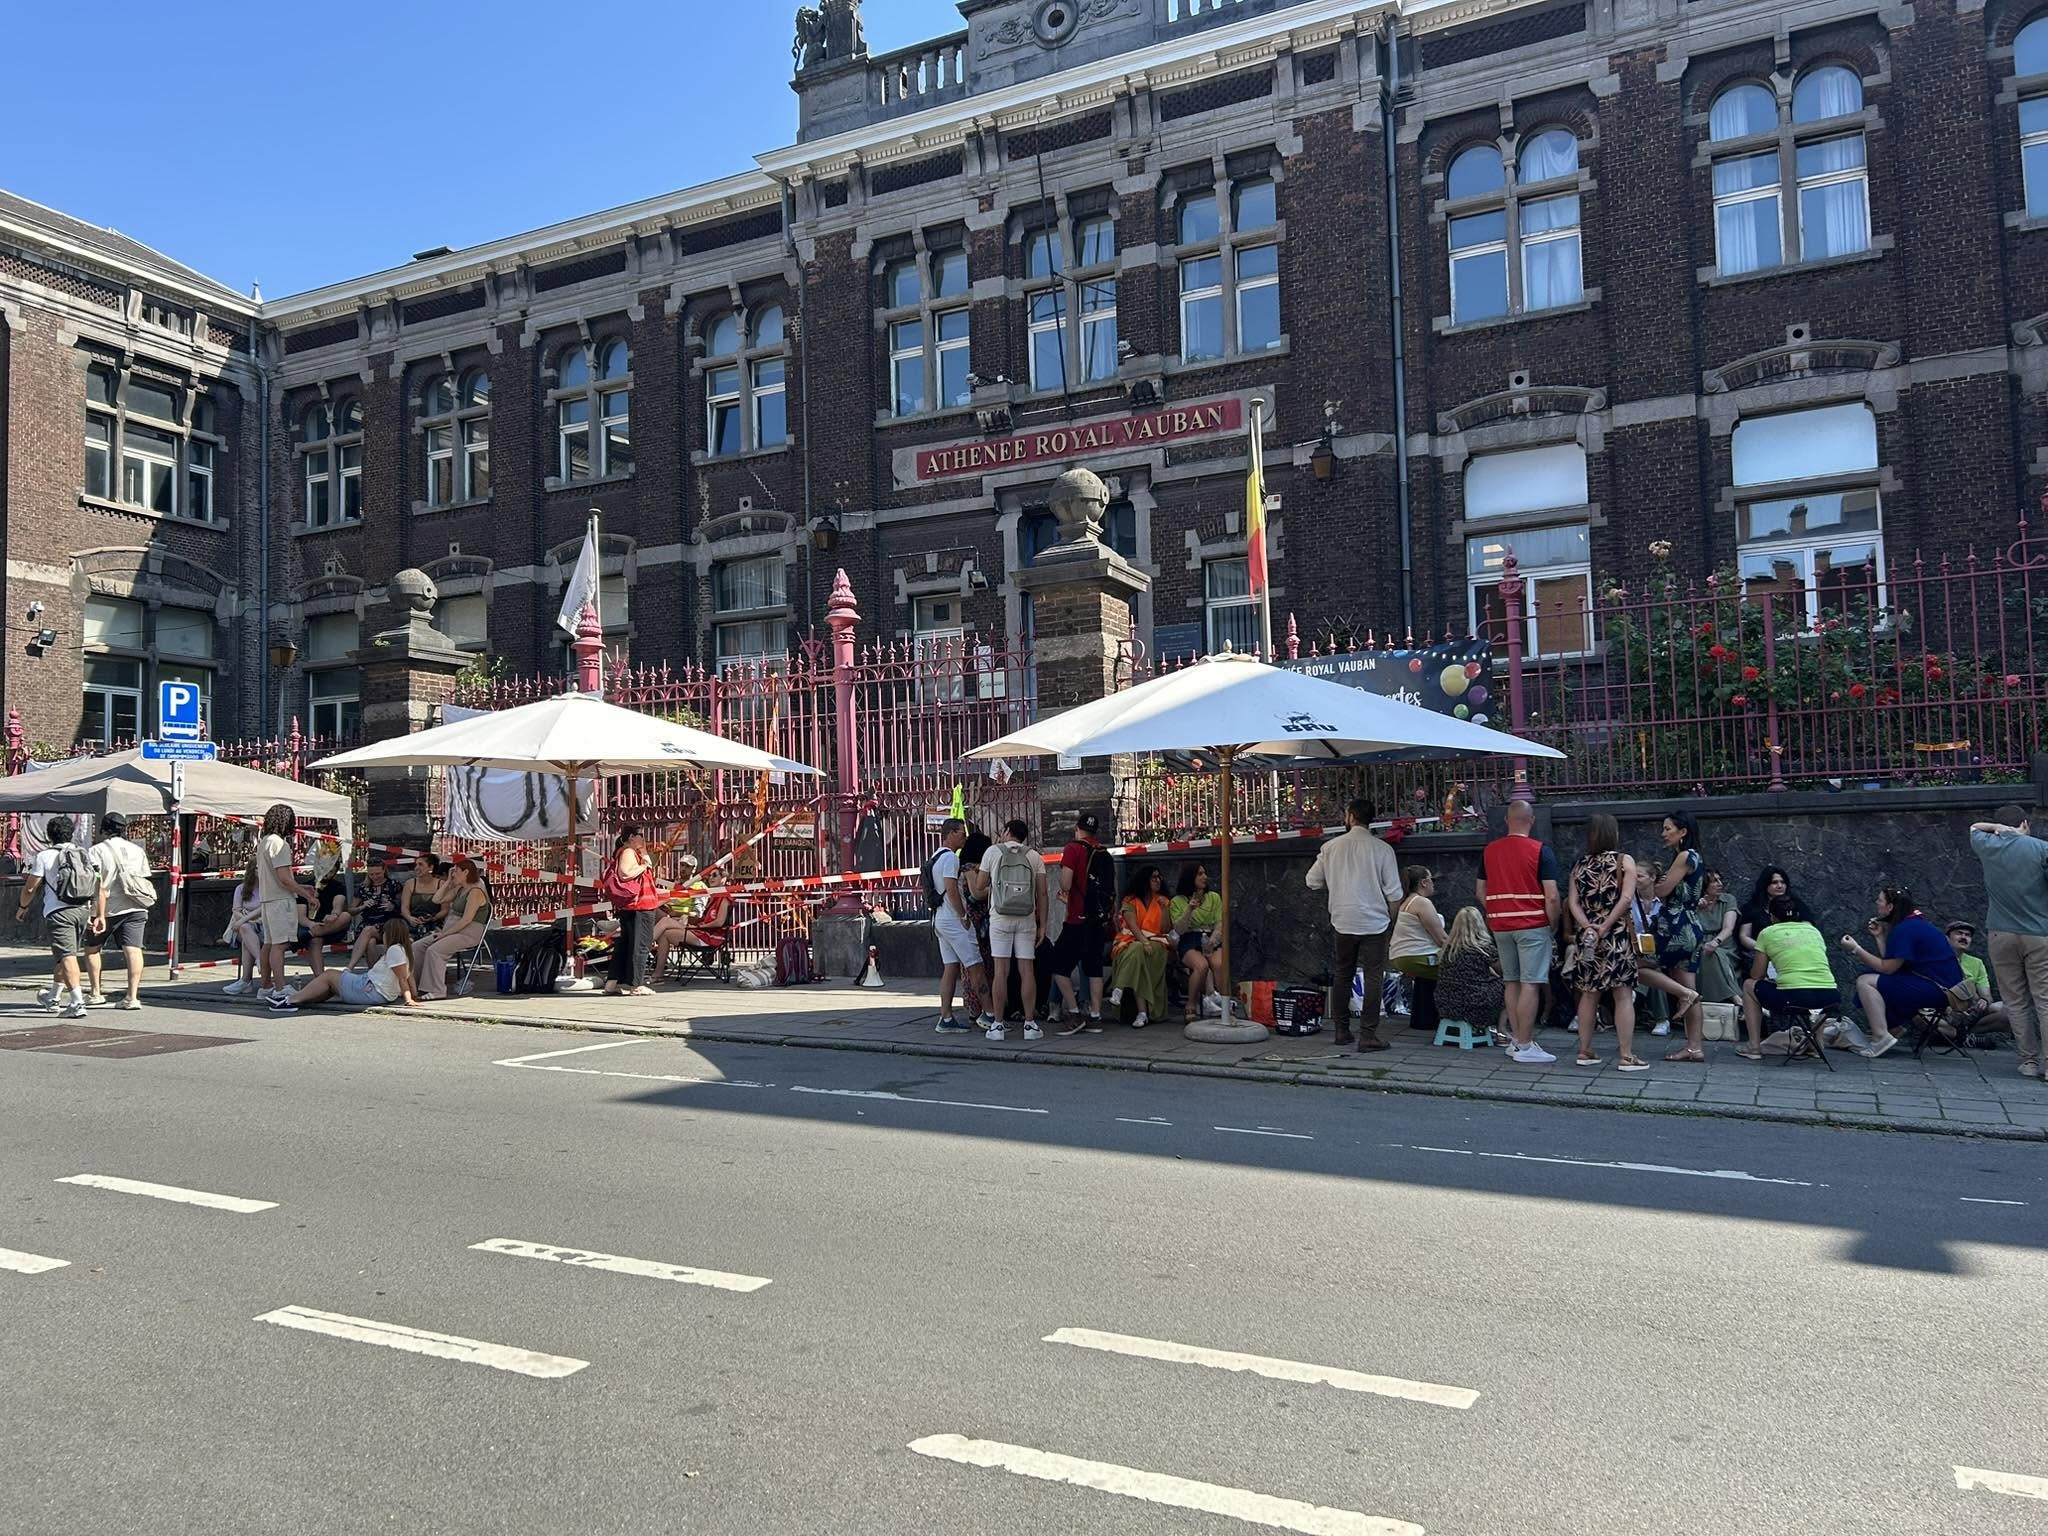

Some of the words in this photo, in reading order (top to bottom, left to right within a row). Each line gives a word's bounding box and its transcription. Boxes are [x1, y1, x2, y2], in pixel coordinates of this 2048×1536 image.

[926, 440, 1027, 474] ATHENEE
[1036, 424, 1114, 455] ROYAL
[1122, 405, 1224, 441] VAUBAN
[1305, 664, 1335, 677] ROYAL
[1338, 658, 1376, 673] VAUBAN
[170, 687, 190, 716] P
[1281, 723, 1339, 732] BRU
